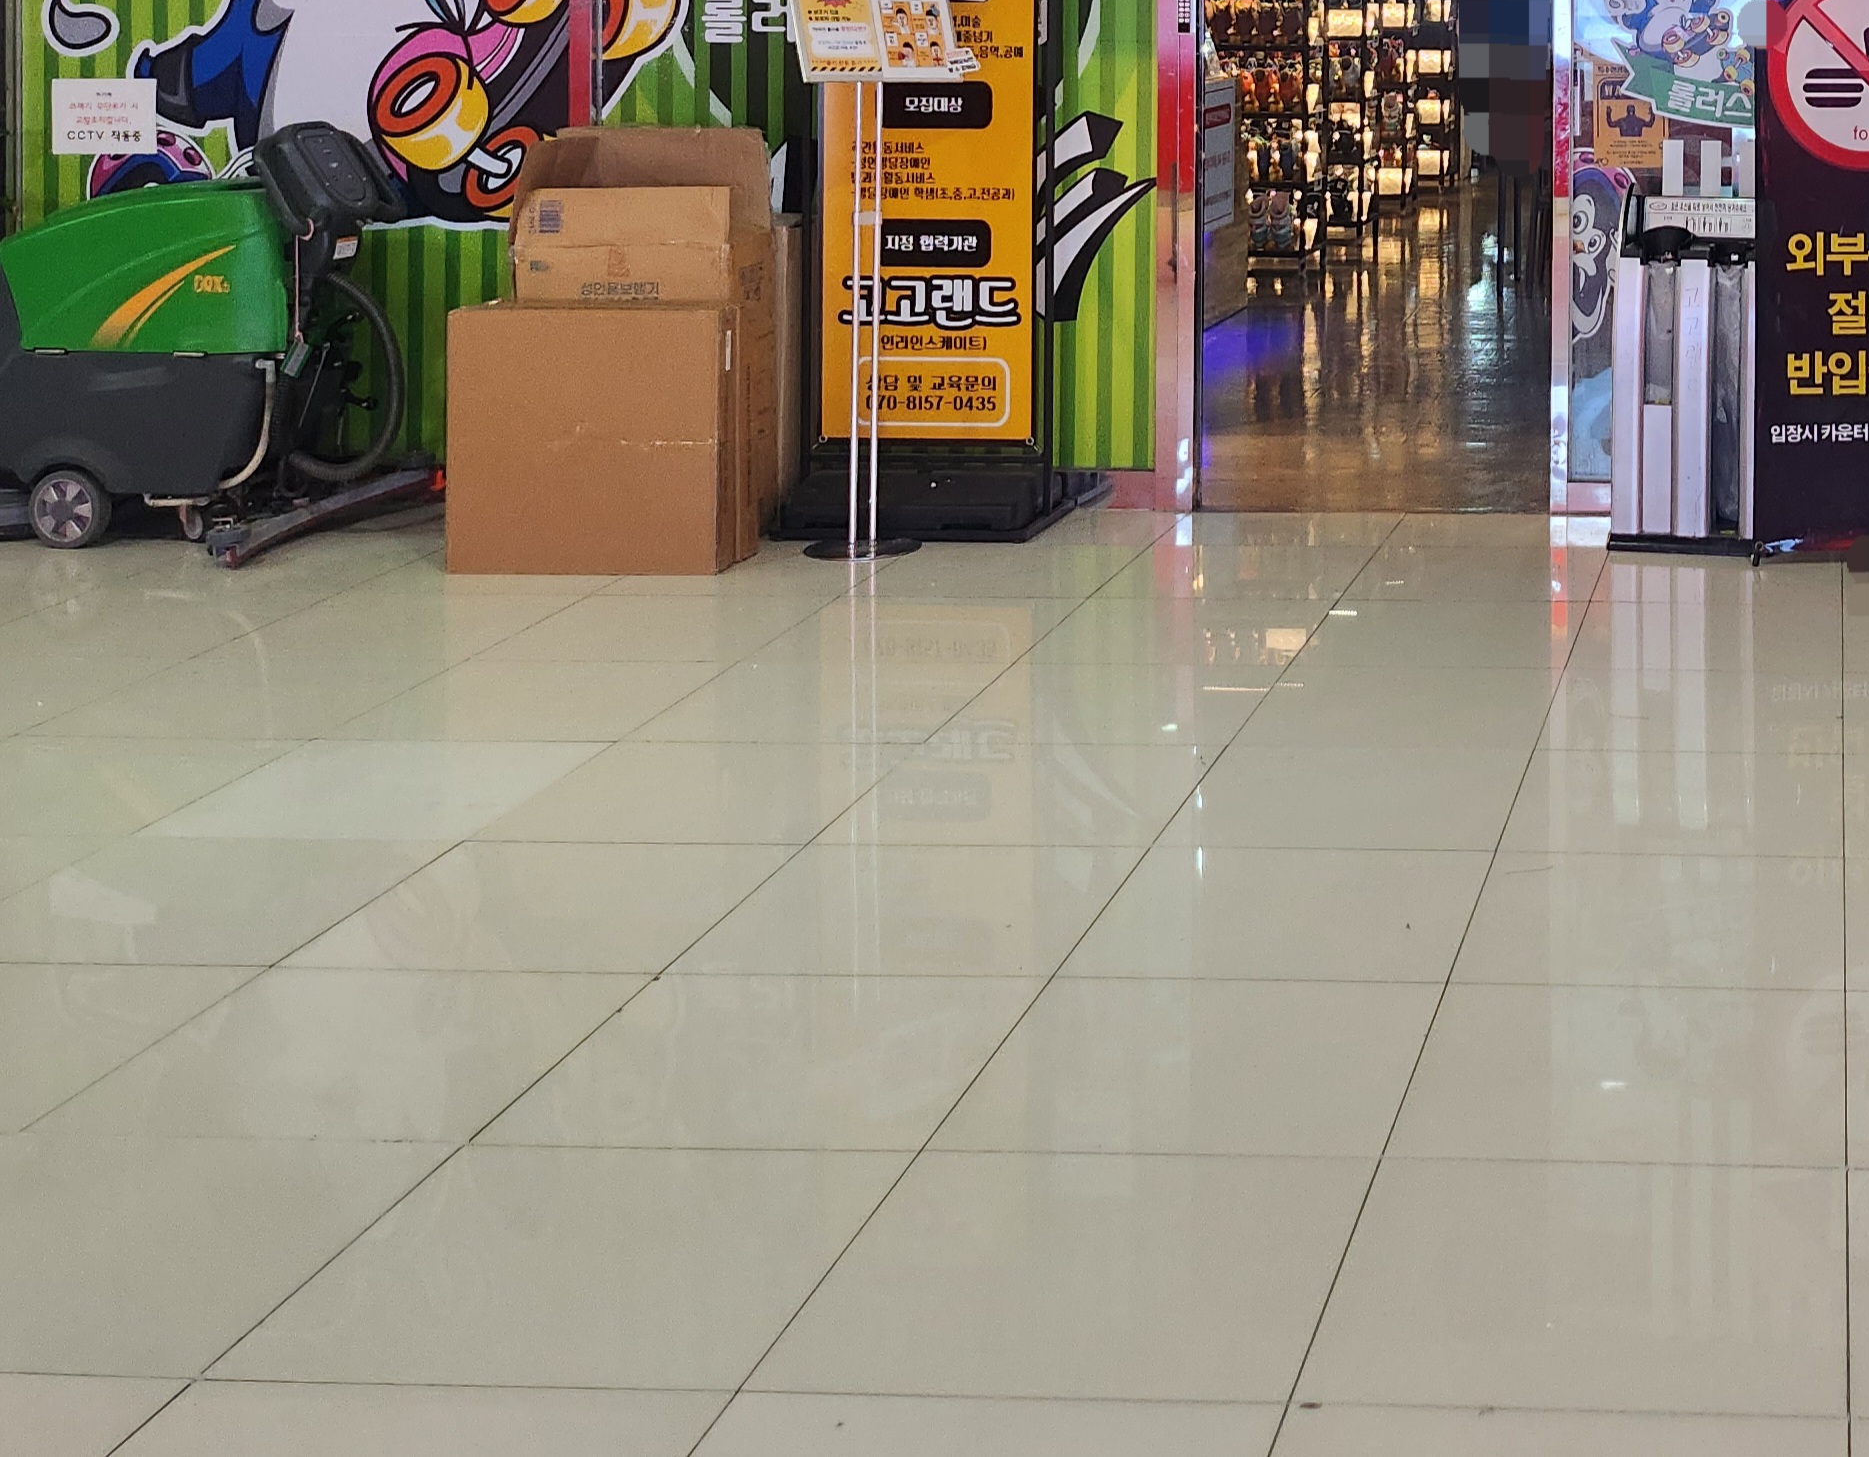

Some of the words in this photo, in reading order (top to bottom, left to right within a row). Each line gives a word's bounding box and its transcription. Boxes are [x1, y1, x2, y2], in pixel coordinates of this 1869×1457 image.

[904, 97, 963, 113] 모집대상
[67, 130, 104, 141] CCTV
[111, 130, 142, 142] 작동중
[884, 235, 914, 251] 지정
[918, 235, 978, 252] 협력기관
[580, 281, 660, 297] 성인용보행기
[839, 275, 1021, 330] 고고랜드
[906, 375, 924, 392] 및
[930, 375, 998, 392] 교육문의
[866, 394, 998, 412] 070-8157-0435
[1769, 423, 1819, 444] 입장시
